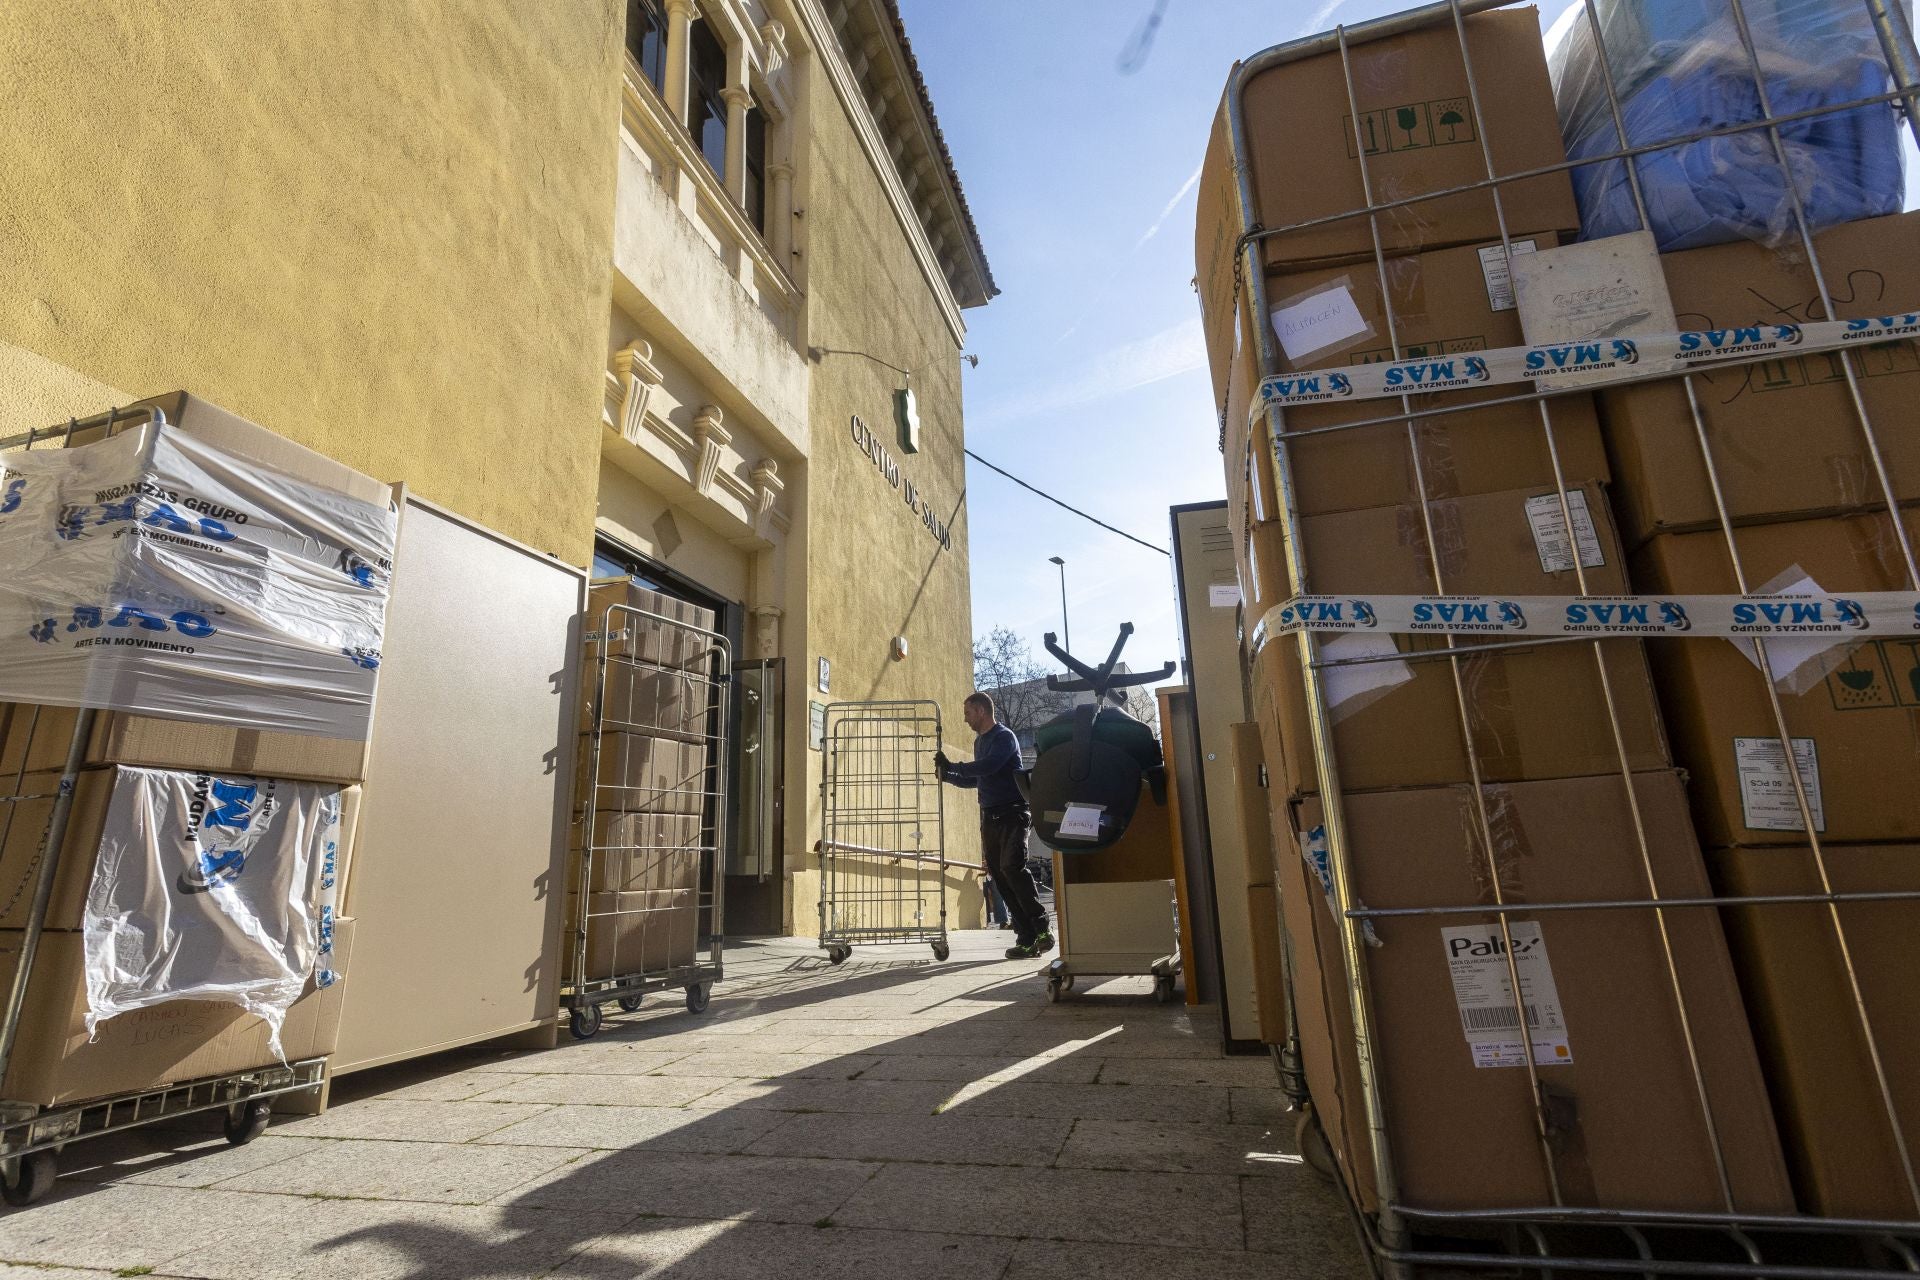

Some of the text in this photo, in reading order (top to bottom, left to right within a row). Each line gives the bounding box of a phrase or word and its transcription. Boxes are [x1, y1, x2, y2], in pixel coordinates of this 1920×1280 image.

[1679, 327, 1762, 351] MAS
[1842, 328, 1882, 340] GRUPO
[1525, 343, 1601, 370] MAS
[1674, 341, 1776, 360] MUDANZAS GRUPO
[1385, 360, 1455, 385] MAS
[1523, 361, 1616, 378] MUDANZAS GRUPO
[1262, 376, 1320, 399] MAS
[1383, 378, 1469, 393] MUDANZAS GRUPO
[1285, 392, 1333, 404] MUDANZAS
[851, 415, 951, 551] CENTRO DE SALUD
[94, 479, 249, 525] MUDANZAS GRUPO
[149, 531, 224, 554] MOVIMIENTO
[1280, 602, 1342, 624] MAS
[1413, 602, 1488, 623] MAS
[1566, 603, 1649, 624] MAS
[1732, 602, 1824, 625] MAS
[1280, 621, 1356, 632] MUDANZAS GRUPO
[1446, 623, 1504, 631] MUDANZAS
[1563, 624, 1665, 632] MUDANZAS GRUPO
[1775, 624, 1842, 632] MUDANZAS
[74, 637, 195, 654] ARTE EN MOVIMIENTO
[262, 793, 274, 817] ARTE
[321, 841, 336, 874] MAS
[321, 905, 334, 943] MAS
